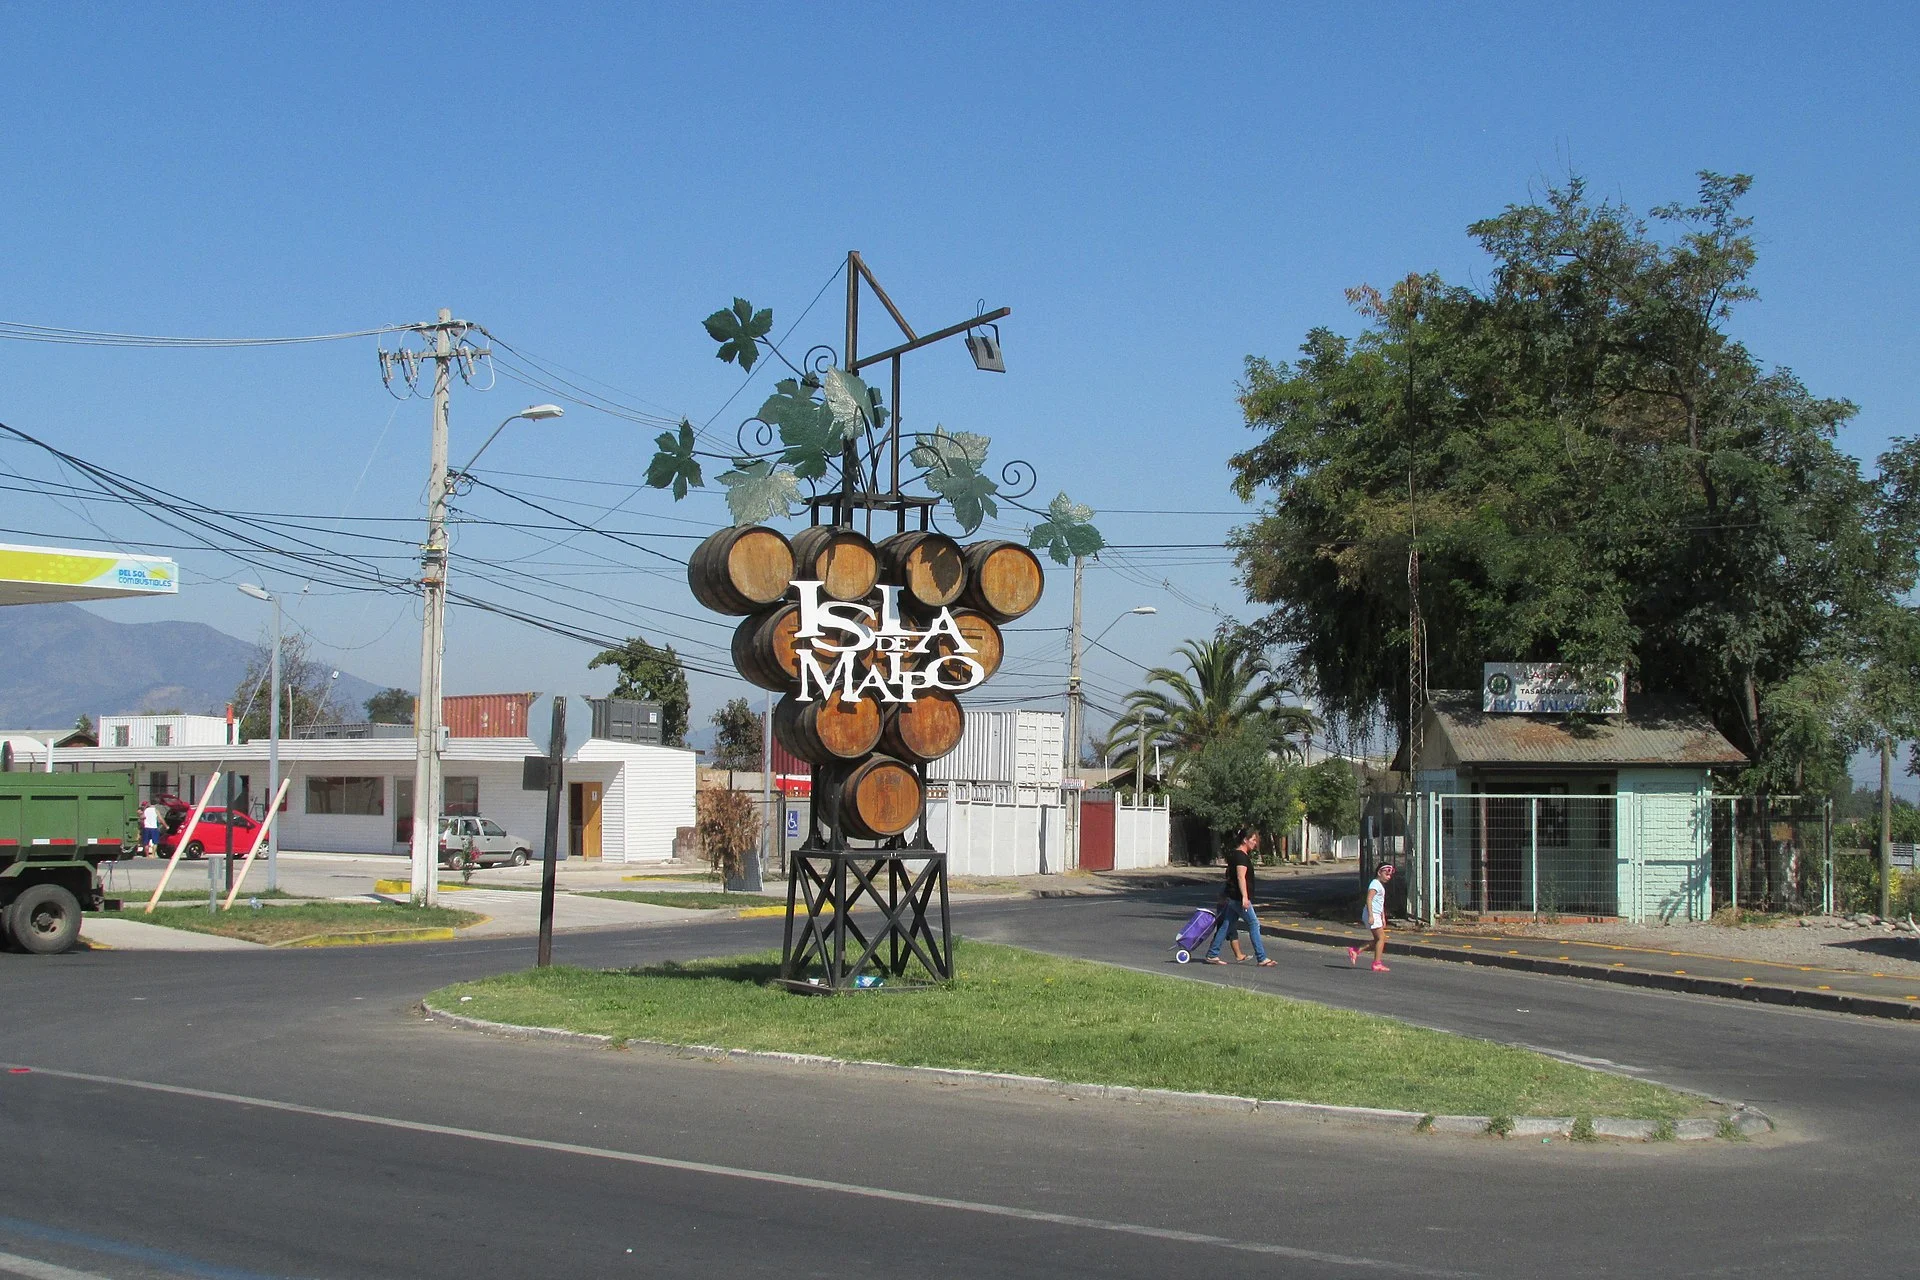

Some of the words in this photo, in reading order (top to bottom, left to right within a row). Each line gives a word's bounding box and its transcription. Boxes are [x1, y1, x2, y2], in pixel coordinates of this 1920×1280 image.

[118, 569, 131, 577] DEL
[132, 570, 146, 578] SOL
[118, 576, 172, 587] COMBUSTIBLES
[788, 580, 978, 654] ISLA
[876, 636, 911, 652] DE
[795, 649, 985, 703] MAIPO
